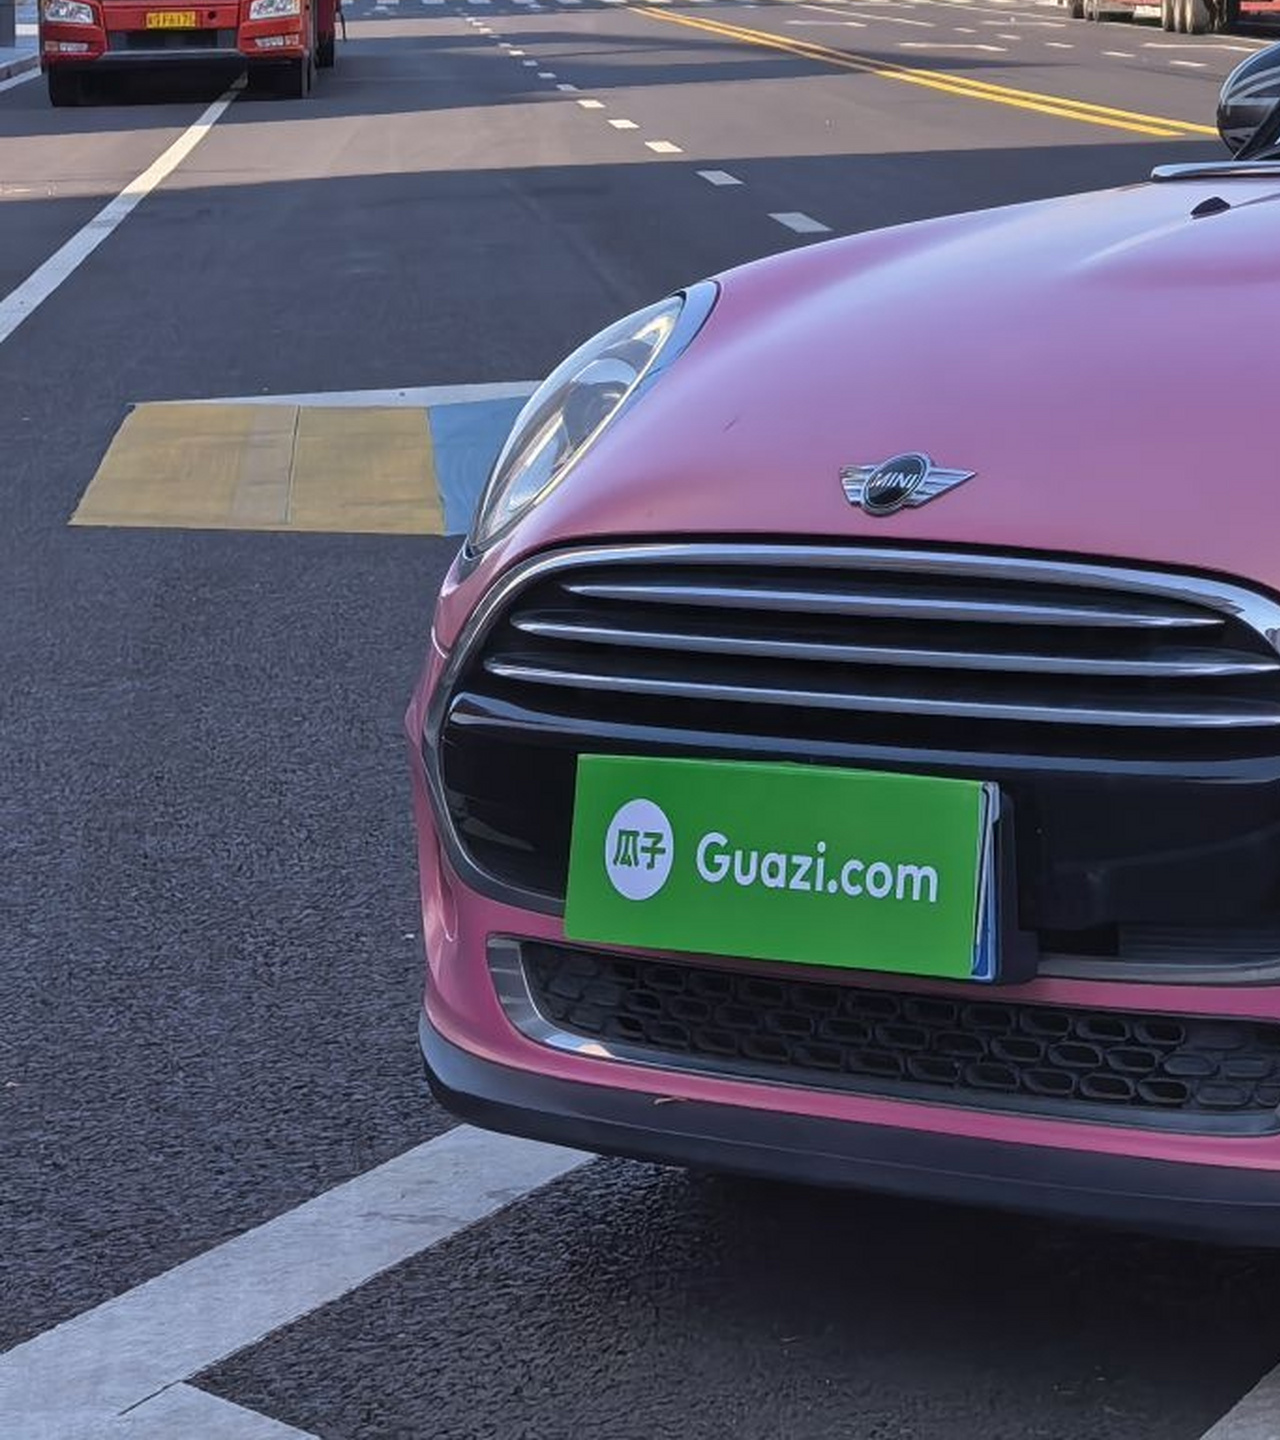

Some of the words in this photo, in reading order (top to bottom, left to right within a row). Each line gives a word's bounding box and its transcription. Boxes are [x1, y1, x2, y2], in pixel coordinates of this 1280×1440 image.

[868, 472, 918, 489] MINI
[613, 829, 666, 870] 瓜子
[696, 832, 938, 903] Guazi.com
